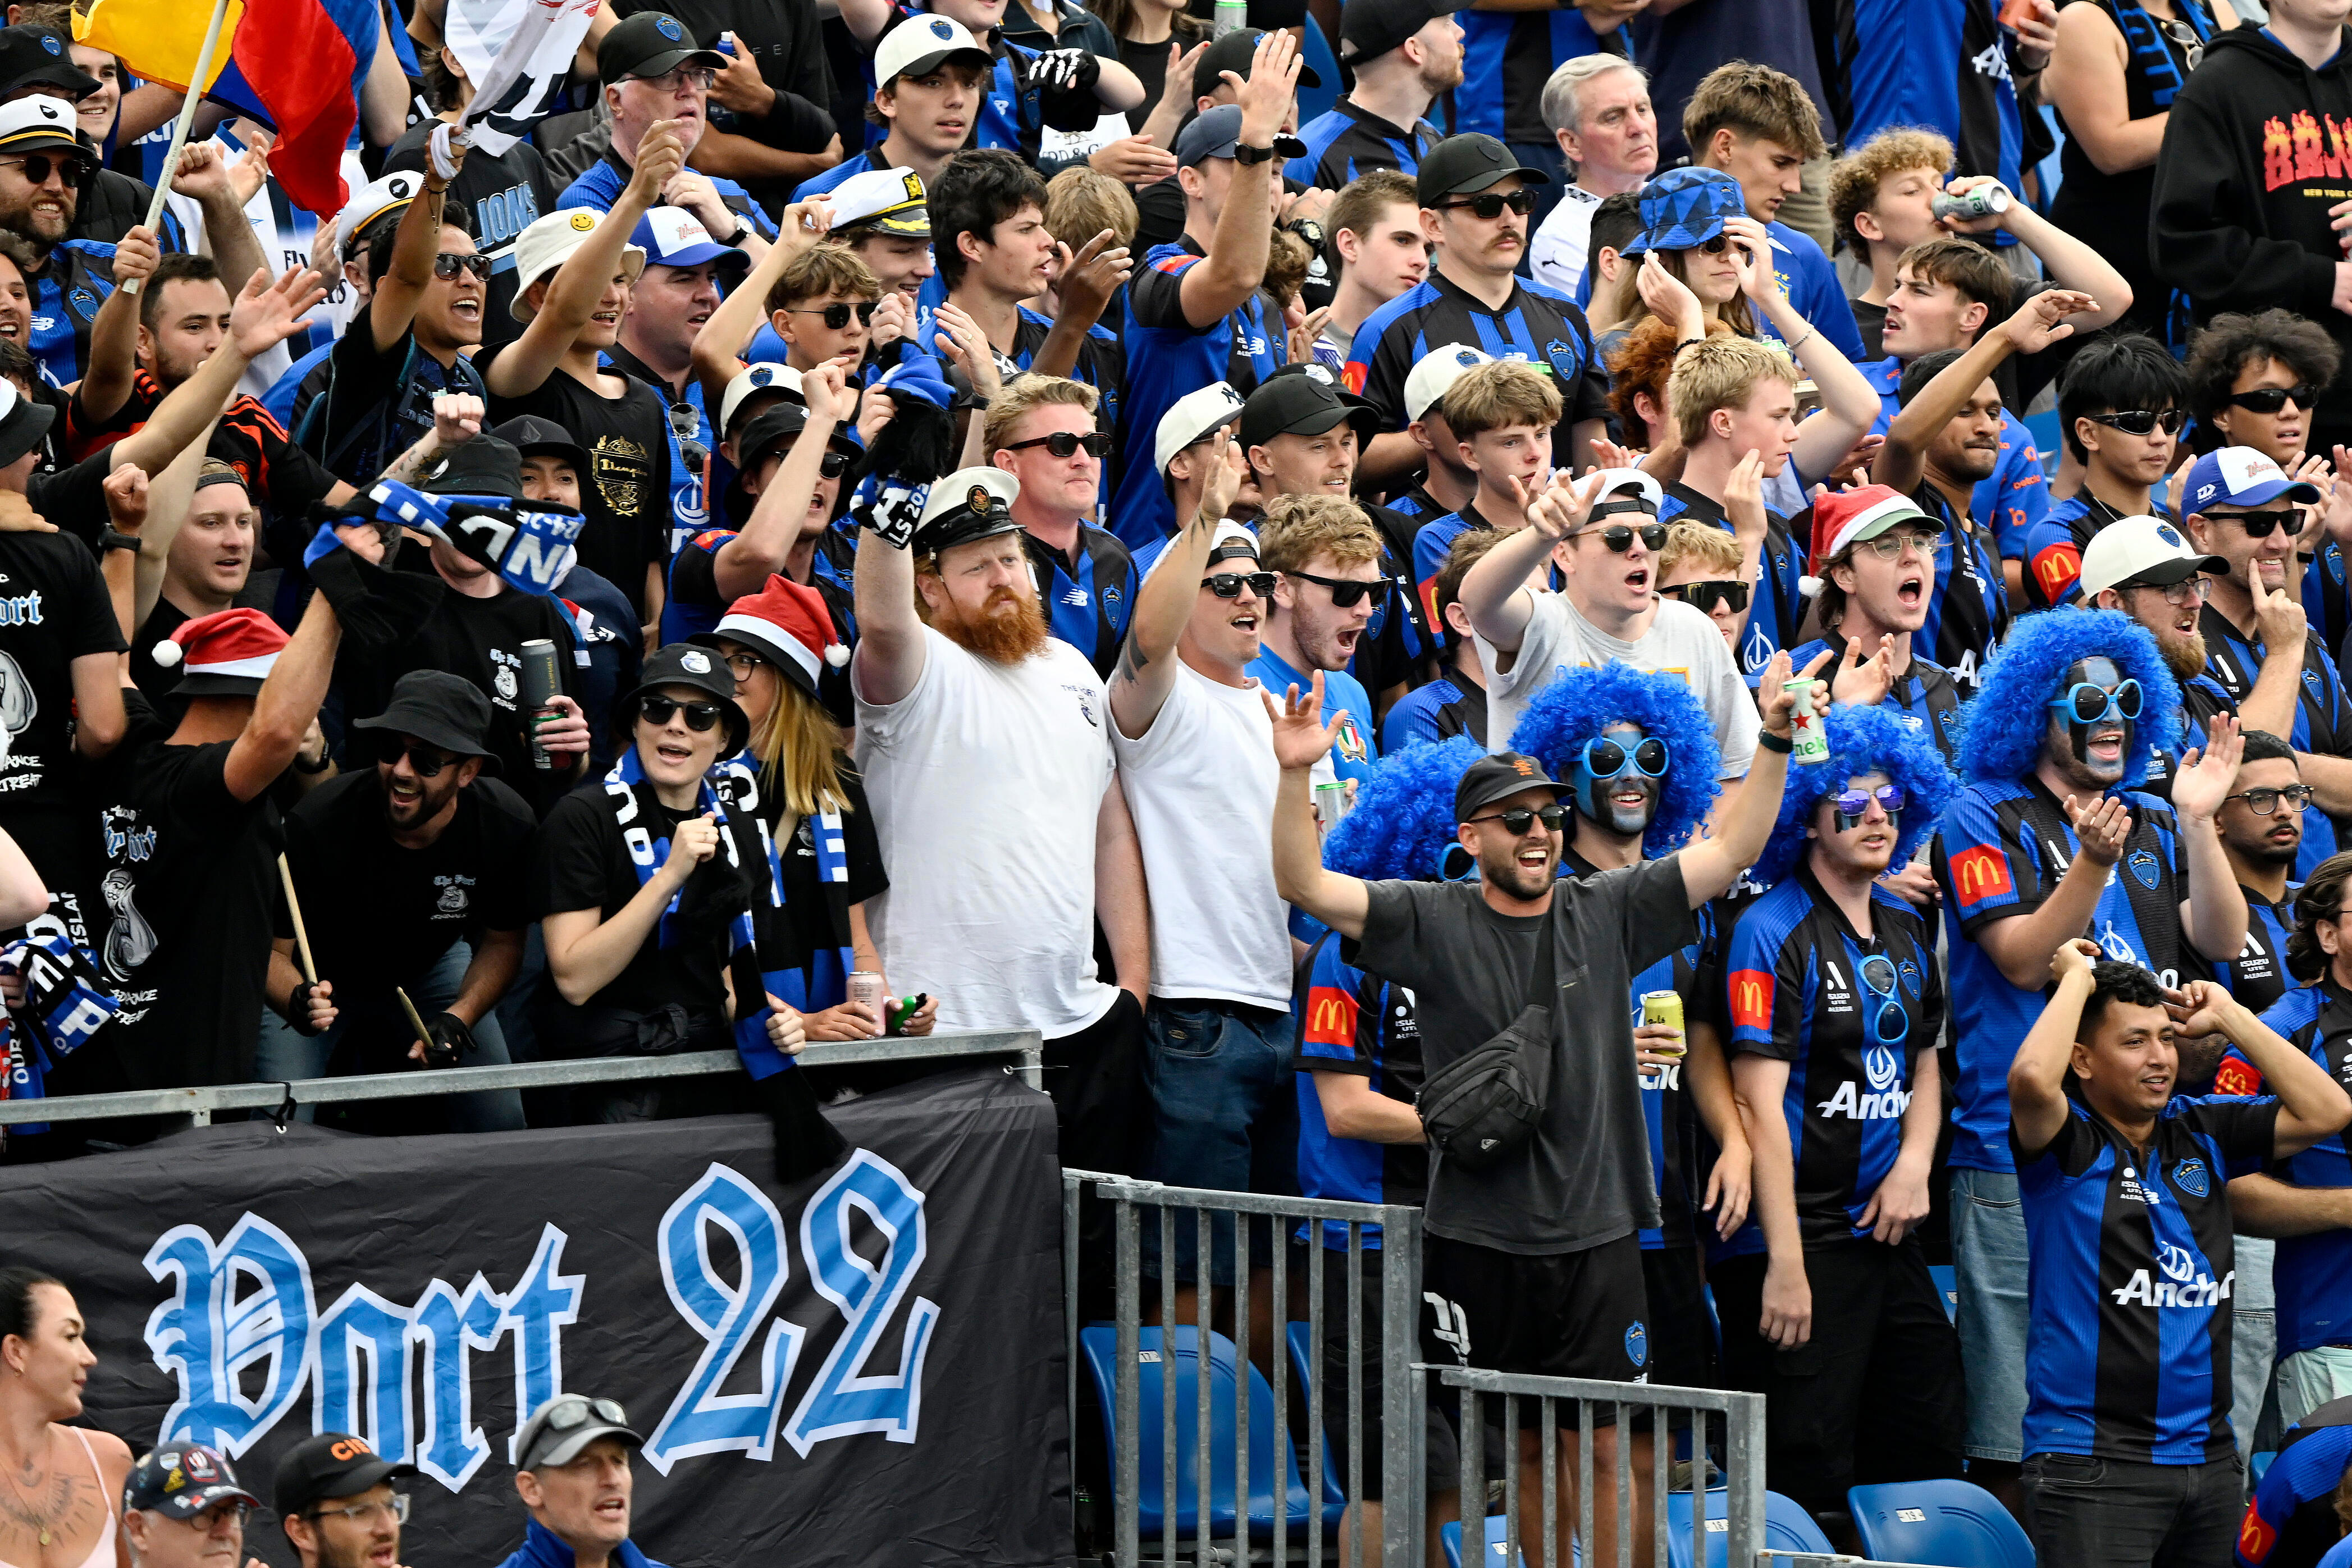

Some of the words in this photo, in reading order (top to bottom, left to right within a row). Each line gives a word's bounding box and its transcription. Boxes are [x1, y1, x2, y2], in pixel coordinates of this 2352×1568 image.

[2303, 189, 2323, 198] NEW
[2324, 189, 2347, 198] YORK
[476, 181, 540, 250] IONS
[0, 589, 44, 626] ort
[2240, 958, 2269, 967] ISUZU
[143, 1210, 586, 1493] Port
[641, 1148, 941, 1477] 22
